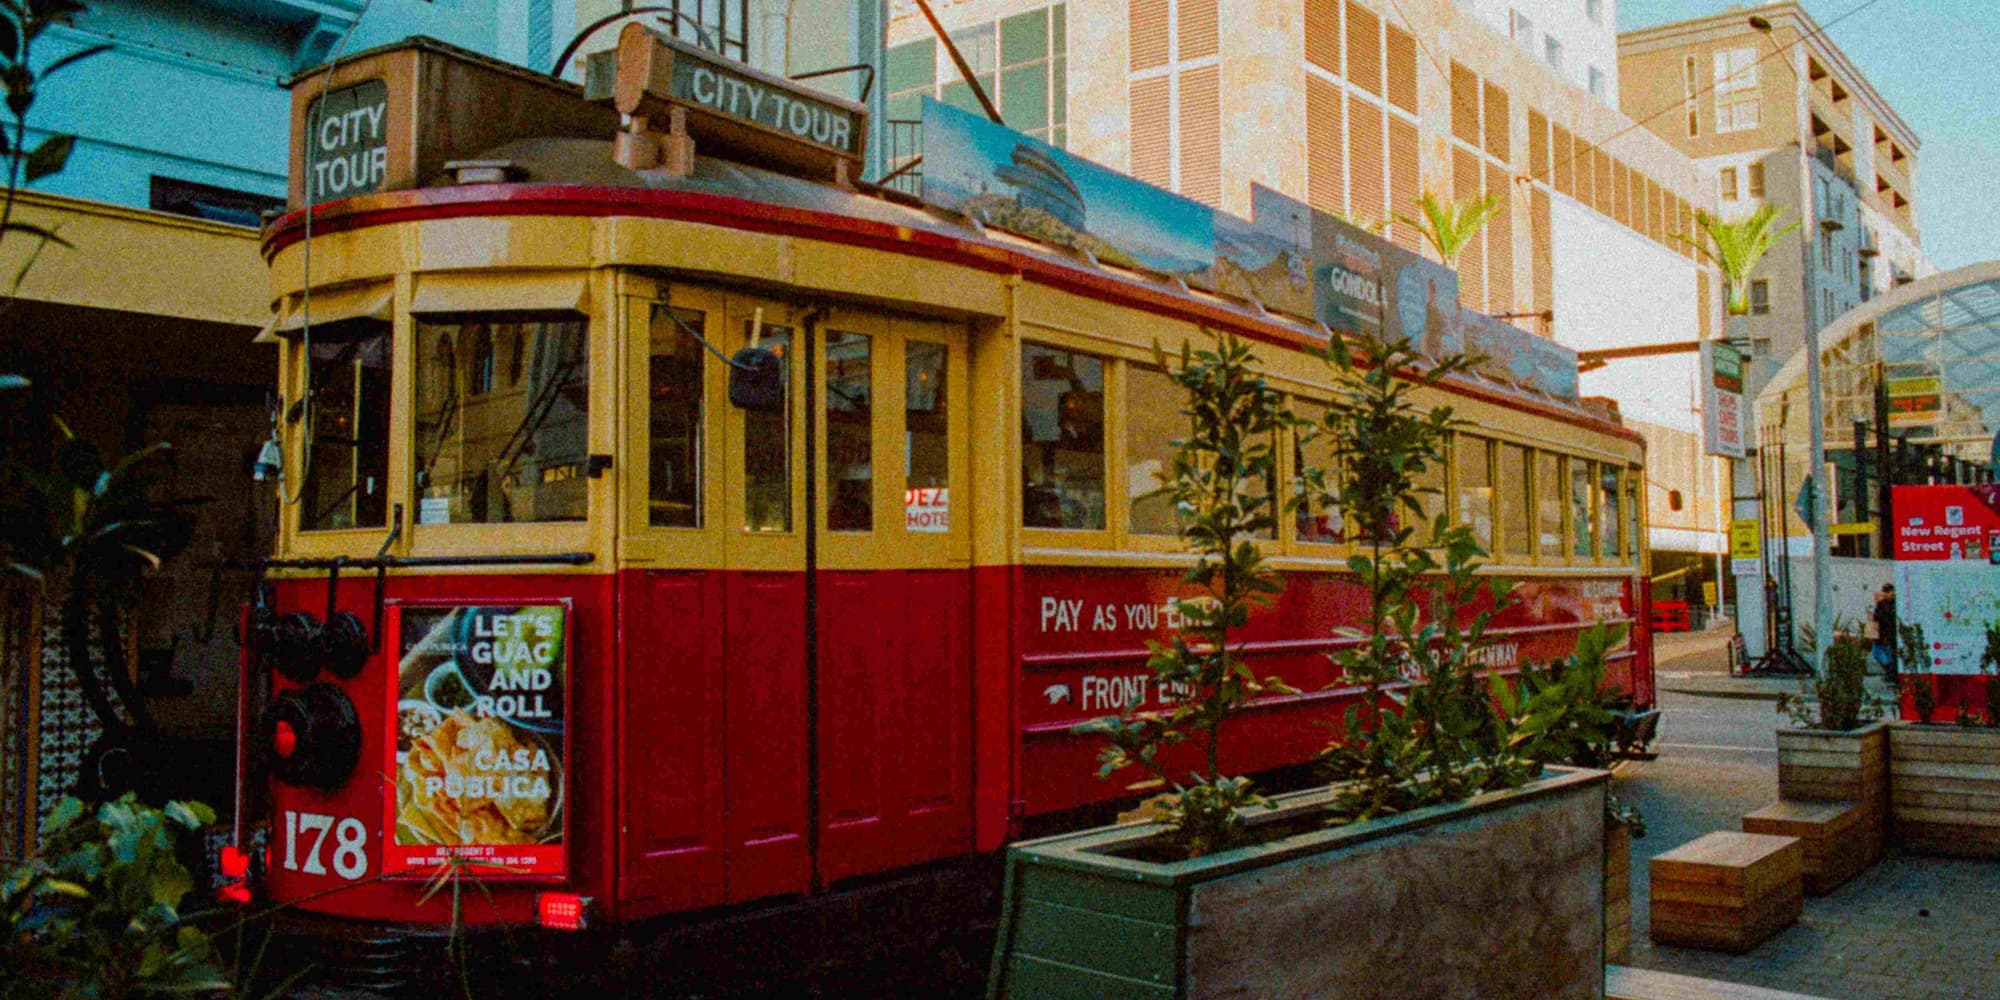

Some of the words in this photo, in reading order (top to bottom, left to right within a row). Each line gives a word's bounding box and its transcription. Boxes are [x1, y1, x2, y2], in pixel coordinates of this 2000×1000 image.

[693, 68, 765, 120] CITY
[771, 94, 850, 150] TOUR
[321, 102, 386, 151] CITY
[315, 146, 388, 198] TOUR
[1901, 527, 1930, 536] New
[1934, 526, 1981, 538] Regent
[1902, 541, 1944, 551] Street
[475, 614, 553, 637] LET'S
[1041, 597, 1083, 632] PAY
[1092, 604, 1117, 631] AS
[1124, 603, 1158, 630] YOU
[472, 641, 551, 664] GUAC
[489, 668, 552, 690] AND
[1082, 675, 1149, 711] FRONT
[476, 695, 551, 718] ROLL
[474, 748, 551, 771] CASA
[284, 810, 368, 880] 178
